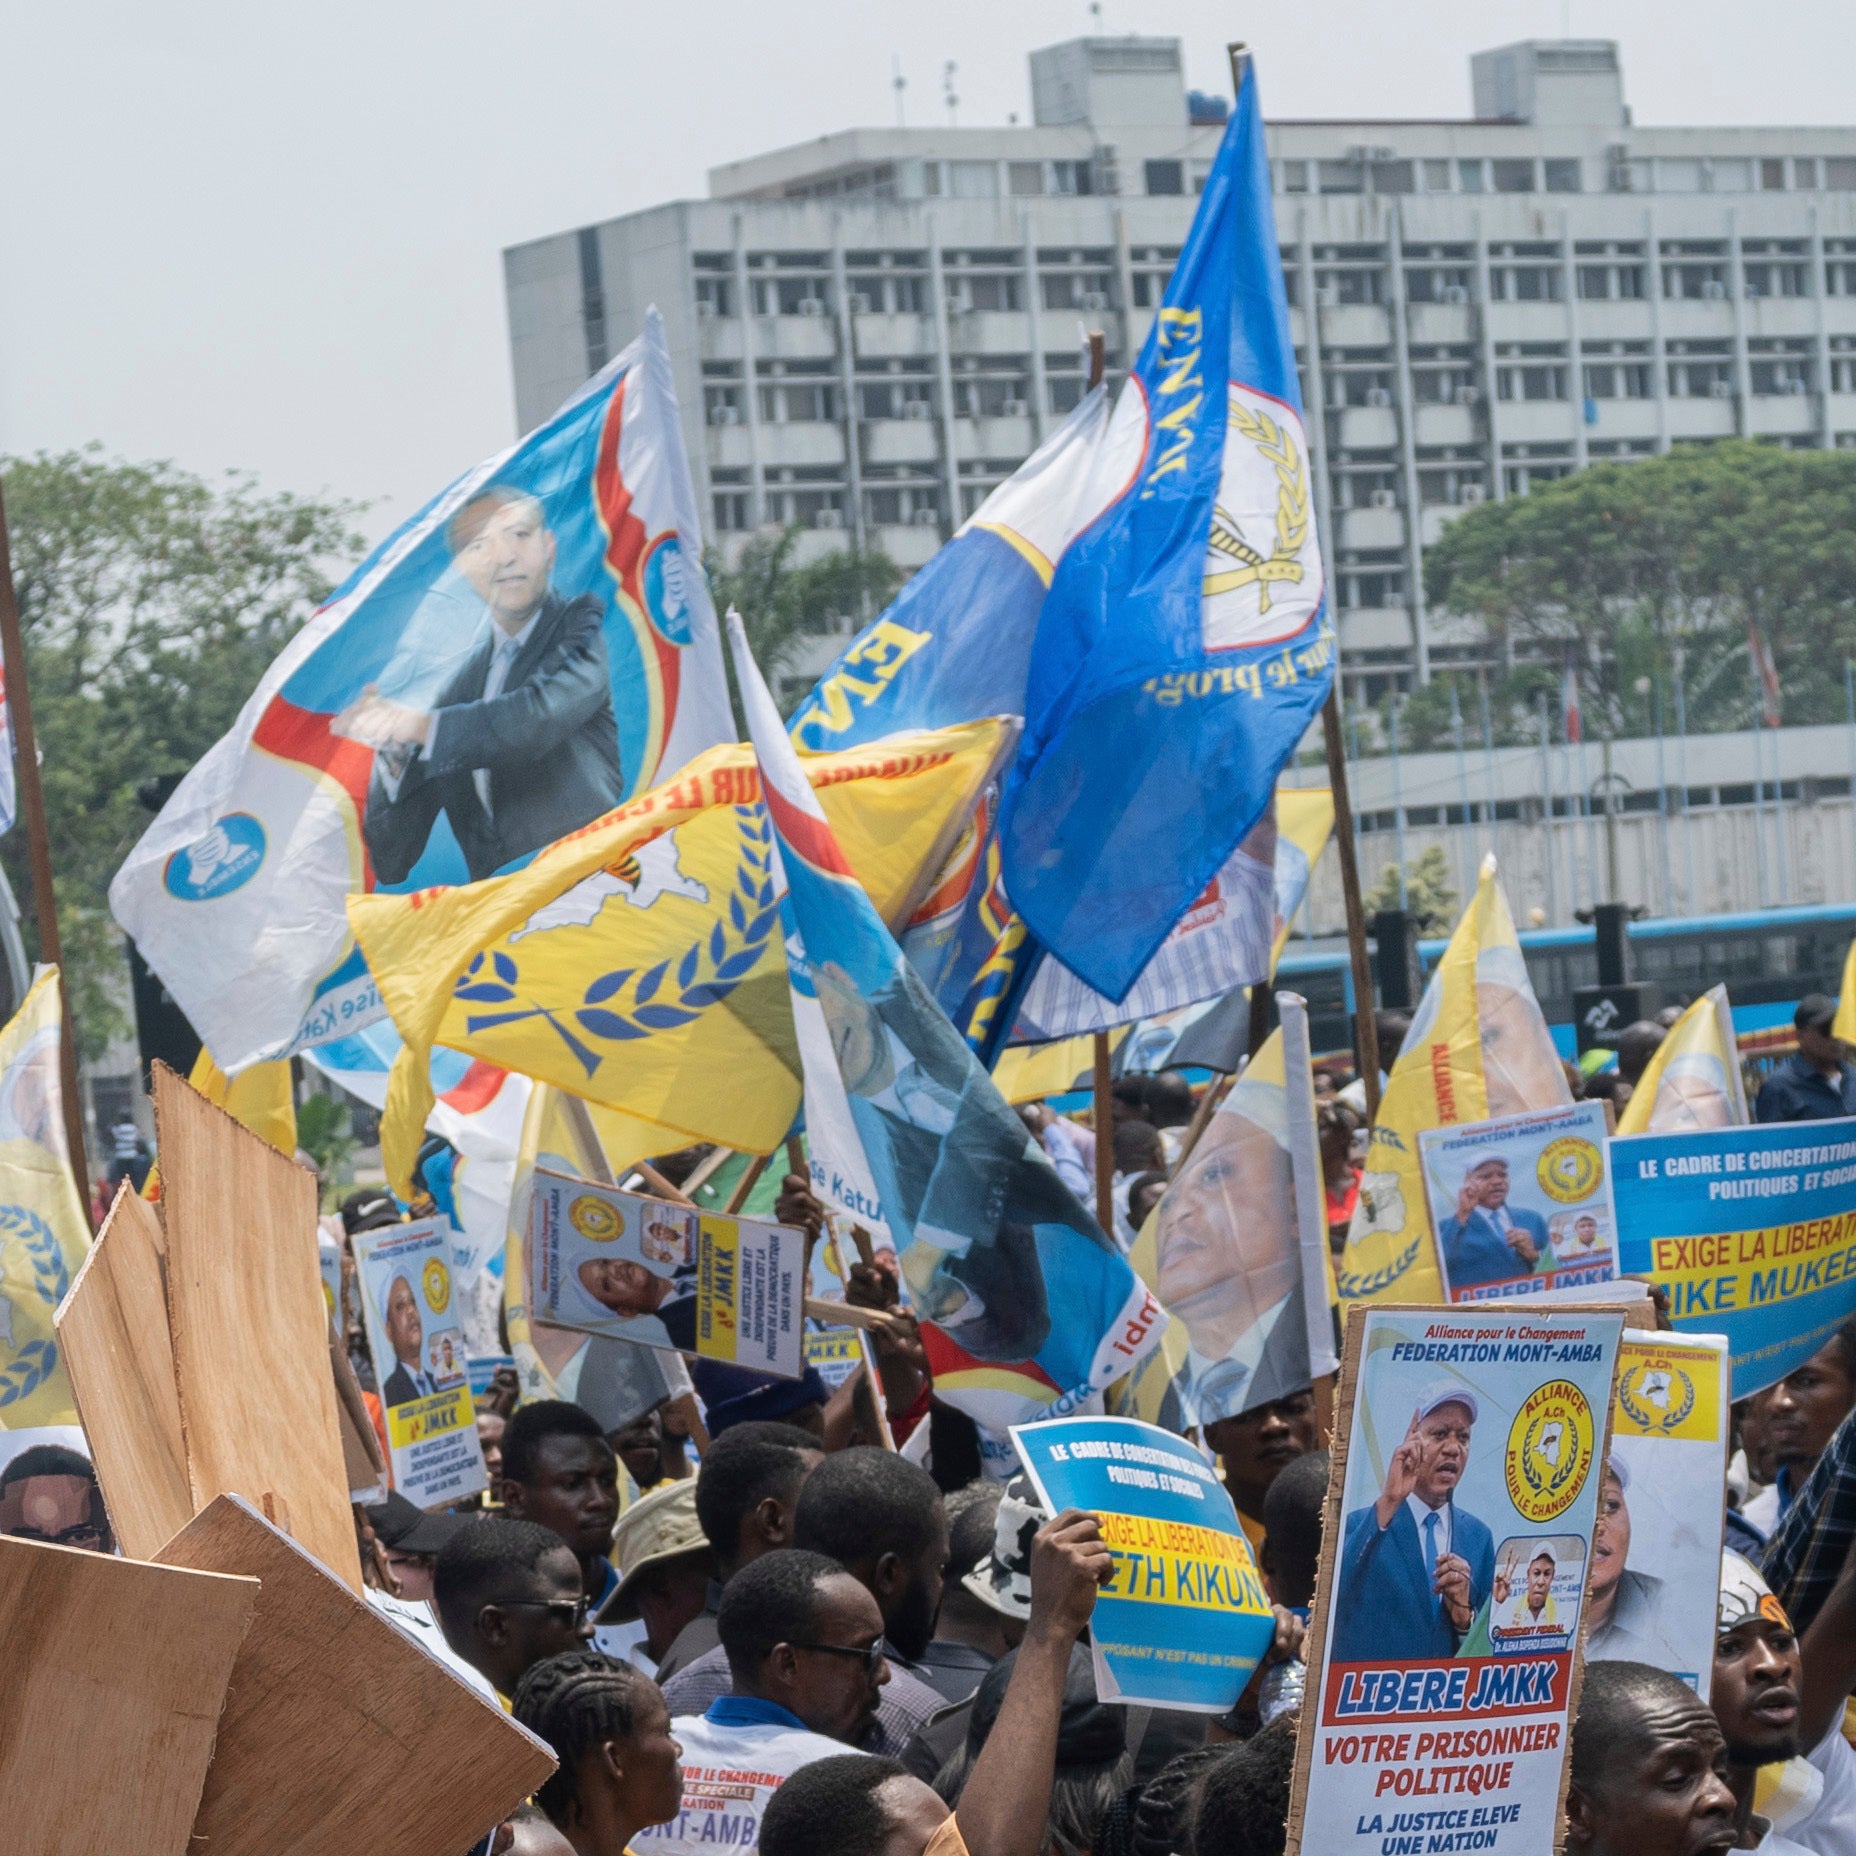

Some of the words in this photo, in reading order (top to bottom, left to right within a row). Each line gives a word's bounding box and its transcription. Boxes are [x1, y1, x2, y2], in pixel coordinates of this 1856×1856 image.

[1639, 1160, 1657, 1179] LE
[1665, 1154, 1721, 1177] CADRE
[1726, 1153, 1746, 1172] DE
[1709, 1173, 1798, 1200] POLITIQUES
[1804, 1170, 1820, 1190] ET
[1656, 1235, 1730, 1271] EXIGE
[1739, 1231, 1767, 1262] LA
[1425, 1325, 1473, 1339] Alliance
[1475, 1326, 1503, 1342] pour
[1505, 1326, 1516, 1339] le
[1518, 1326, 1586, 1343] Changement
[1392, 1343, 1501, 1362] FEDERATION
[1503, 1344, 1603, 1362] MONT-AMBA
[1524, 1384, 1587, 1418] ALLIANCE
[1049, 1444, 1070, 1462] LE
[1507, 1450, 1520, 1500] POUR
[1518, 1497, 1532, 1513] LE
[1531, 1449, 1591, 1517] CHANGEMENT
[1137, 1518, 1159, 1548] LA
[1336, 1665, 1465, 1717] LIBERE
[1470, 1660, 1555, 1711] JMKK
[1323, 1732, 1409, 1766] VOTRE
[1414, 1723, 1561, 1763] PRISONNIER
[704, 1768, 715, 1781] LE
[1374, 1761, 1514, 1798] POLITIQUE
[697, 1785, 751, 1799] SPECIALE
[1356, 1813, 1384, 1835] LA
[1388, 1809, 1468, 1834] JUSTICE
[1471, 1803, 1521, 1829] ELEVE
[1381, 1833, 1425, 1856] UNE
[1428, 1828, 1498, 1853] NATION
